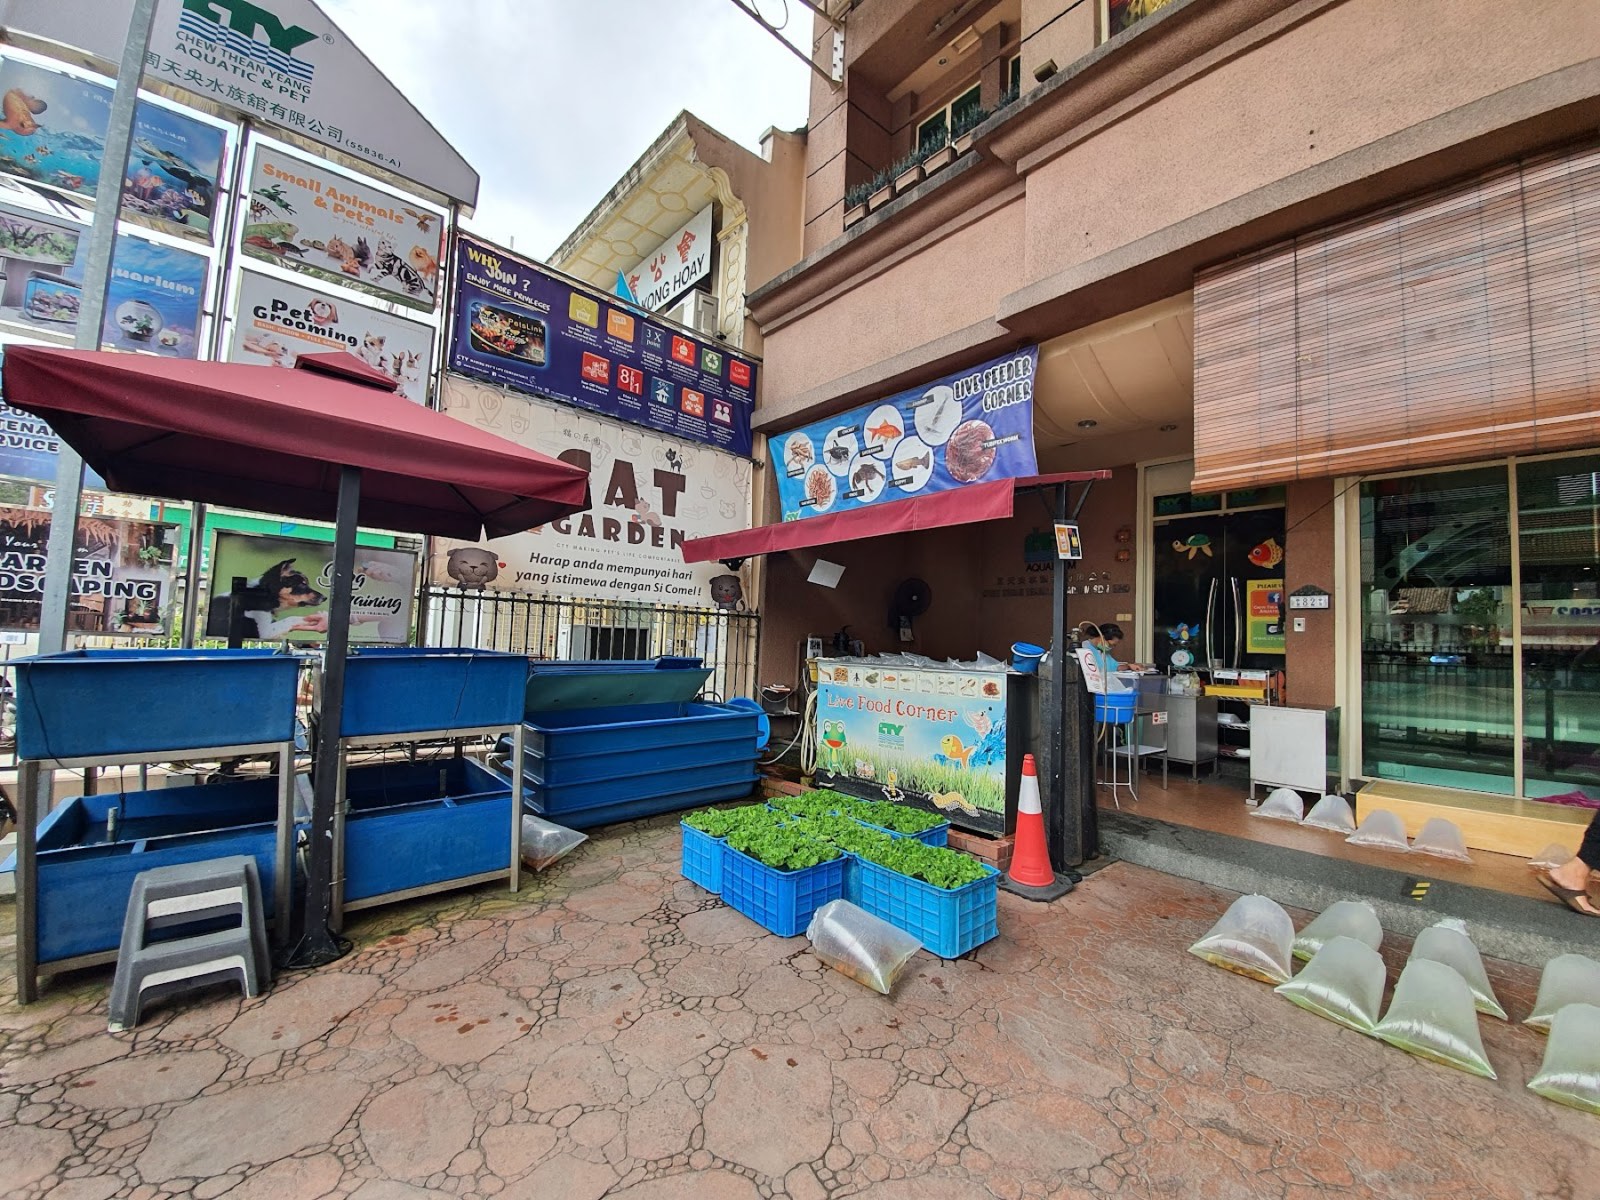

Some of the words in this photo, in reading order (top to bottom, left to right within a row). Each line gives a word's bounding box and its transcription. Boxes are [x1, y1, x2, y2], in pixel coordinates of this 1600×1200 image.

[175, 31, 218, 53] CHEW
[221, 49, 265, 75] THEAN
[269, 69, 311, 94] YEANG
[175, 43, 257, 83] AQUATIC
[262, 79, 274, 90] &
[279, 86, 310, 104] PET
[345, 138, 401, 169] (55836-A)
[263, 163, 322, 193] Small
[325, 186, 405, 224] Animals
[313, 196, 328, 210] &
[333, 202, 375, 227] Pets
[468, 247, 502, 270] WHY
[673, 253, 705, 292] HOAY
[111, 266, 195, 296] uarium
[466, 273, 491, 287] ENJOY
[493, 281, 512, 295] MORE
[514, 291, 551, 311] PRIVILEGES
[485, 267, 517, 285] JOIN
[522, 279, 531, 291] ?
[271, 298, 313, 322] Pet
[253, 305, 358, 347] Grooming
[953, 373, 982, 402] LIVE
[984, 356, 1033, 390] FEEDER
[983, 379, 1032, 413] CORNER
[5, 536, 38, 549] Your
[551, 513, 685, 550] GARDEN
[0, 552, 112, 577] AREN
[530, 552, 570, 571] Harap
[573, 558, 604, 571] anda
[606, 562, 671, 582] mempunyai
[673, 567, 693, 581] hari
[515, 571, 549, 586] yang
[552, 572, 607, 590] istimewa
[609, 577, 651, 595] dengan
[653, 581, 663, 593] Si
[351, 595, 402, 615] aining
[827, 694, 854, 709] Live
[858, 696, 892, 714] Food
[896, 700, 958, 722] Corner
